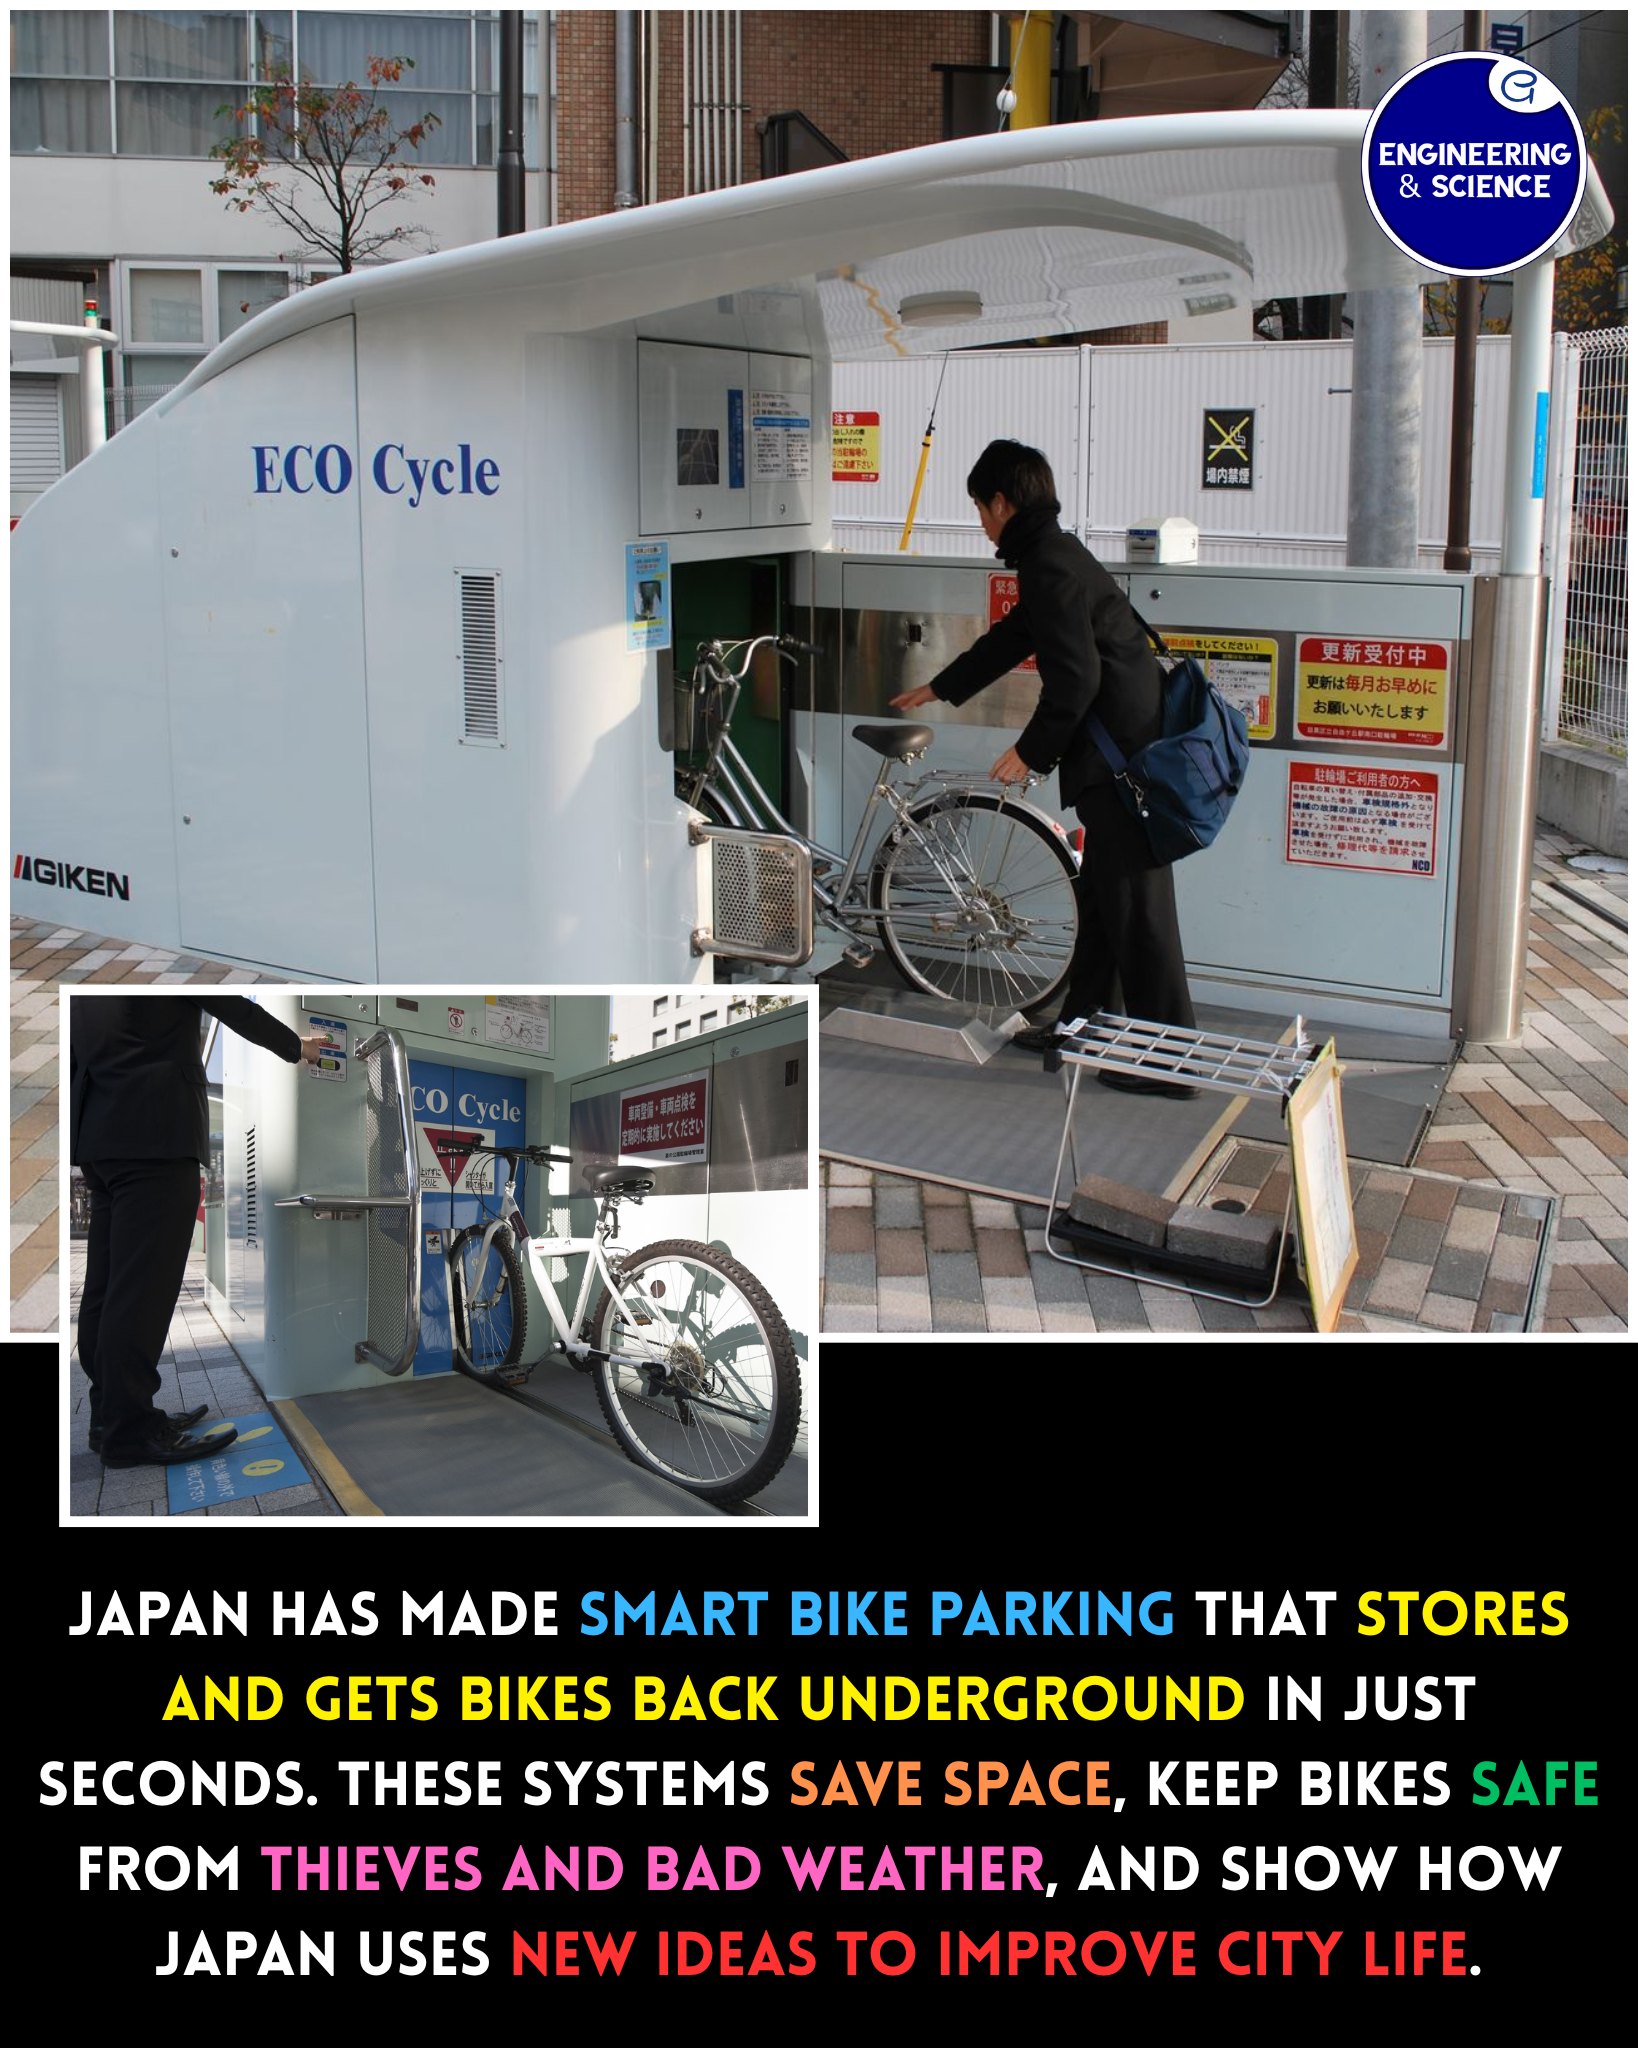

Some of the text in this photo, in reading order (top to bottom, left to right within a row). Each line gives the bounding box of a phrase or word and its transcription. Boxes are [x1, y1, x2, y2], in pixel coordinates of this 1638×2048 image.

[251, 444, 500, 508] ECO Cycle
[1206, 467, 1250, 484] 場内禁煙
[1321, 642, 1427, 667] 更新受付中
[1306, 674, 1437, 695] 更新は毎月お早めに
[1313, 700, 1429, 721] お願いいたします
[1314, 767, 1421, 790] 駐輪場ご利用者の方へ
[34, 857, 130, 902] GIKEN
[411, 1086, 521, 1124] CO Cycle
[628, 1091, 697, 1122] 車両整備・車両点検を
[622, 1118, 704, 1147] 定期的に実施してください
